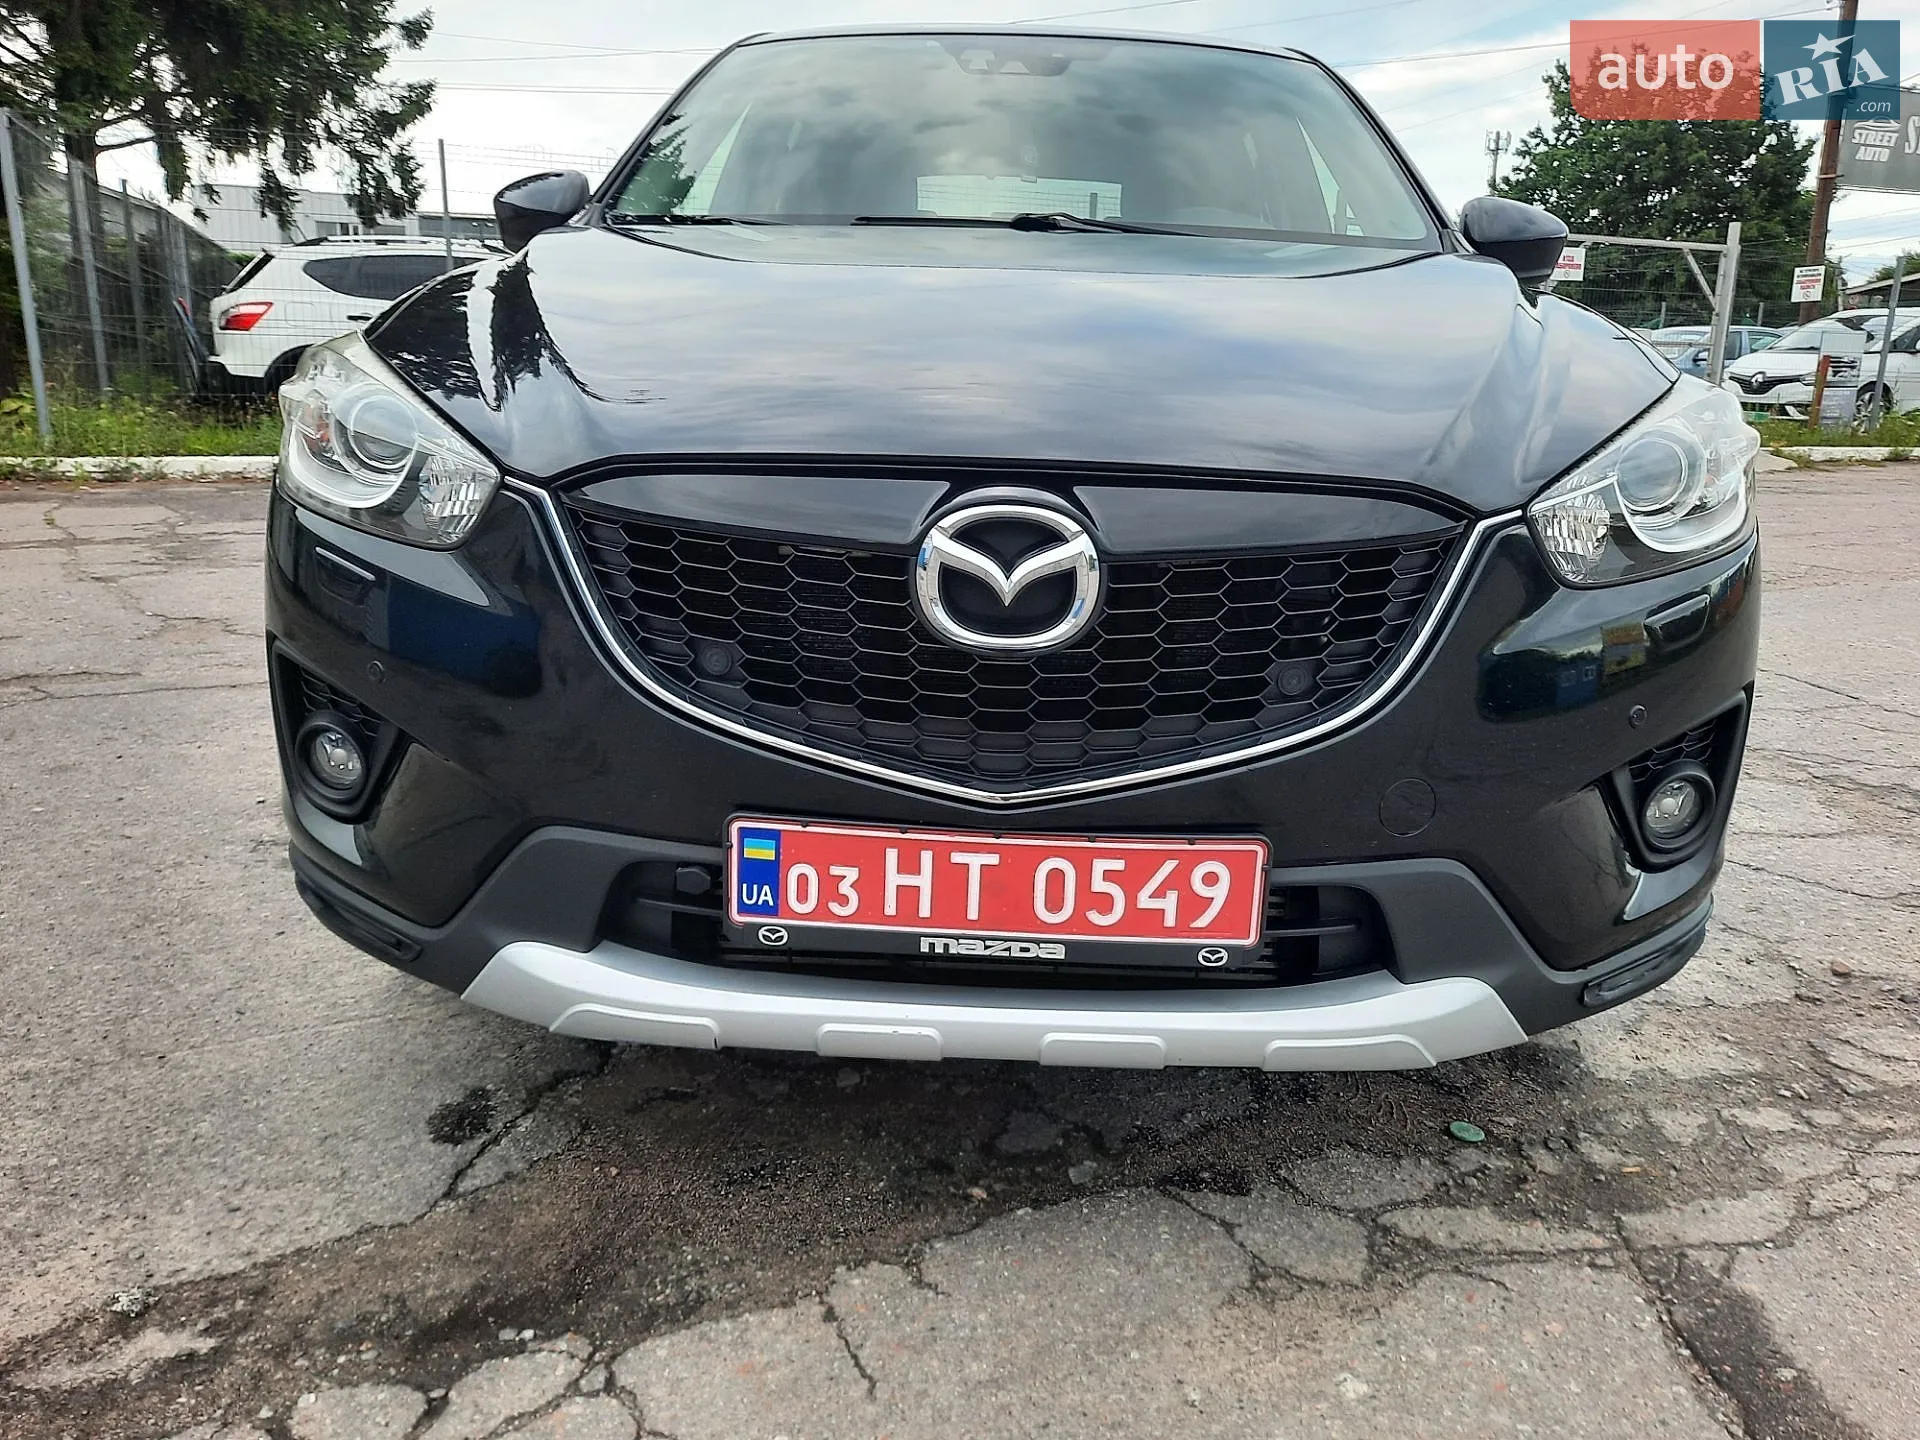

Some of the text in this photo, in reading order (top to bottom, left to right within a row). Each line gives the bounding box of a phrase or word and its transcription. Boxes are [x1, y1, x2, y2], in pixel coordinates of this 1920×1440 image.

[1851, 129, 1899, 147] STREET
[1855, 146, 1890, 162] AUTO
[742, 883, 774, 907] UA
[786, 847, 1231, 928] 03 HT 0549
